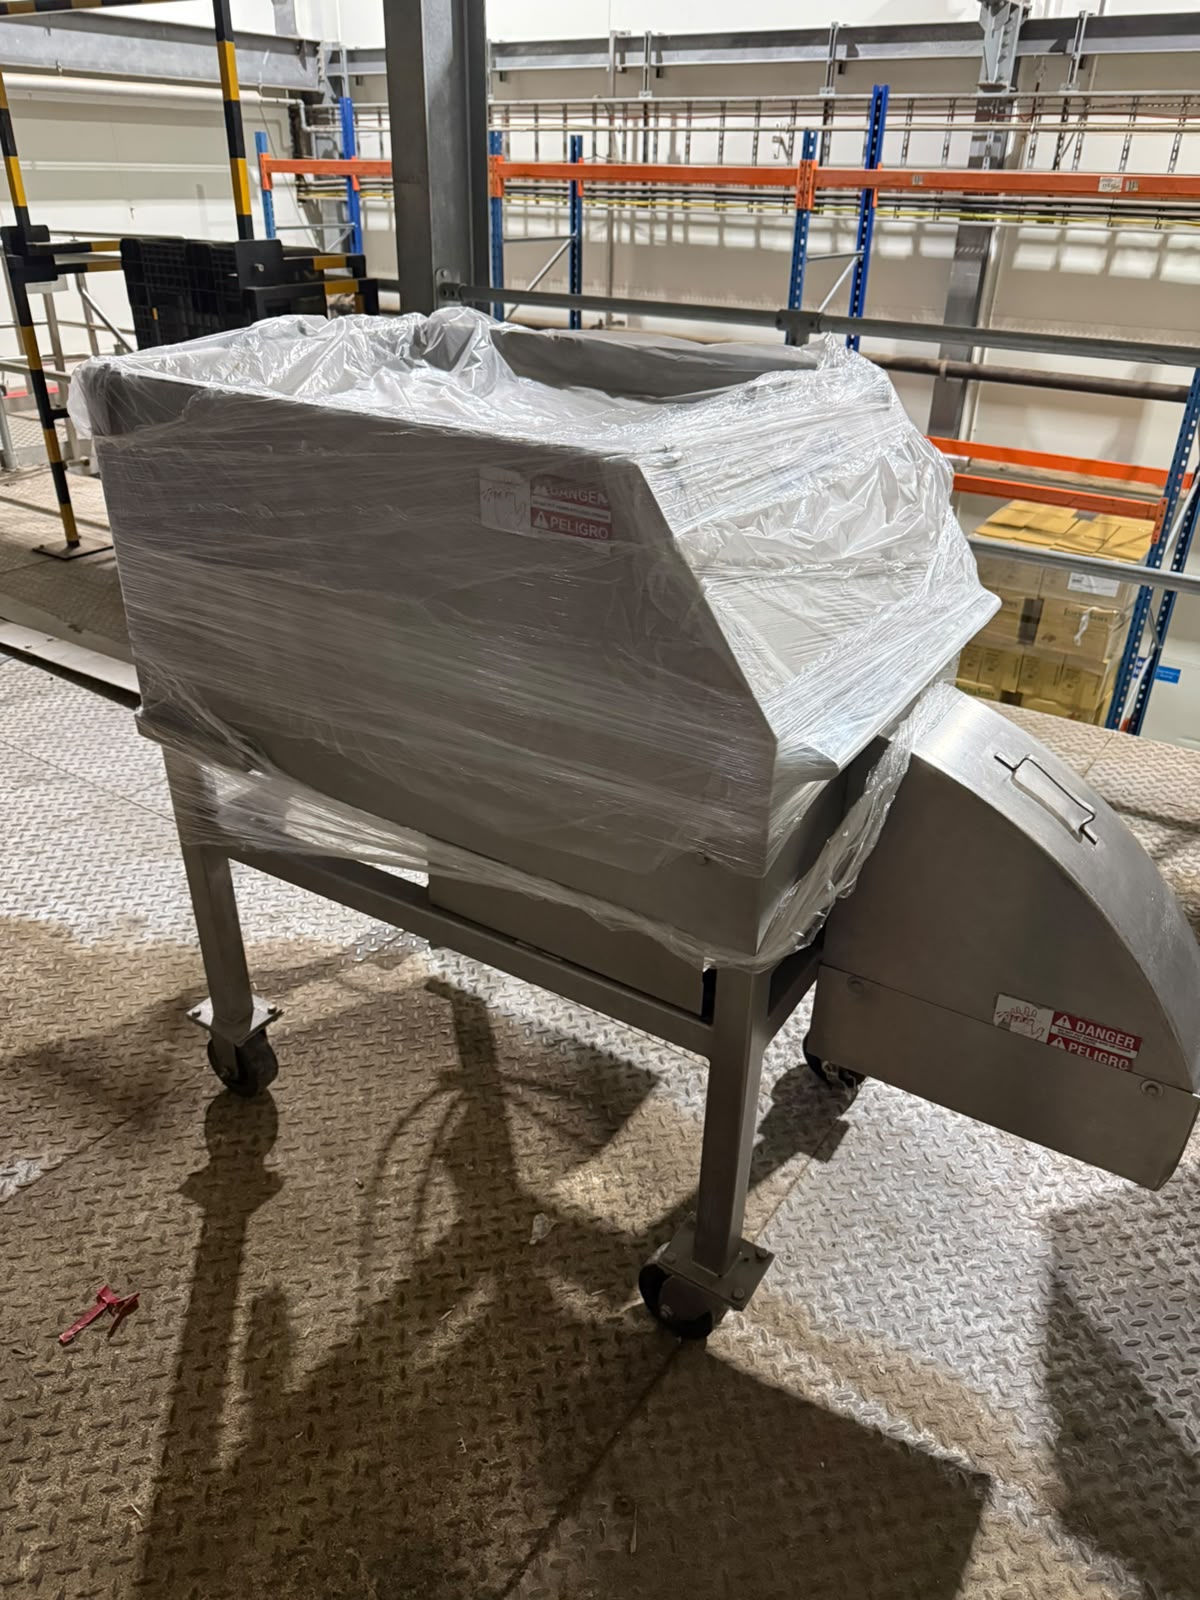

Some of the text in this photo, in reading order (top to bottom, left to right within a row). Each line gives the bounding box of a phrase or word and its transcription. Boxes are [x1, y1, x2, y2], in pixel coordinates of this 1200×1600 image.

[550, 485, 609, 504] DANGER
[550, 516, 609, 540] PELIGRO
[1075, 1020, 1136, 1049] DANGER
[1067, 1042, 1130, 1071] PELIGRO
